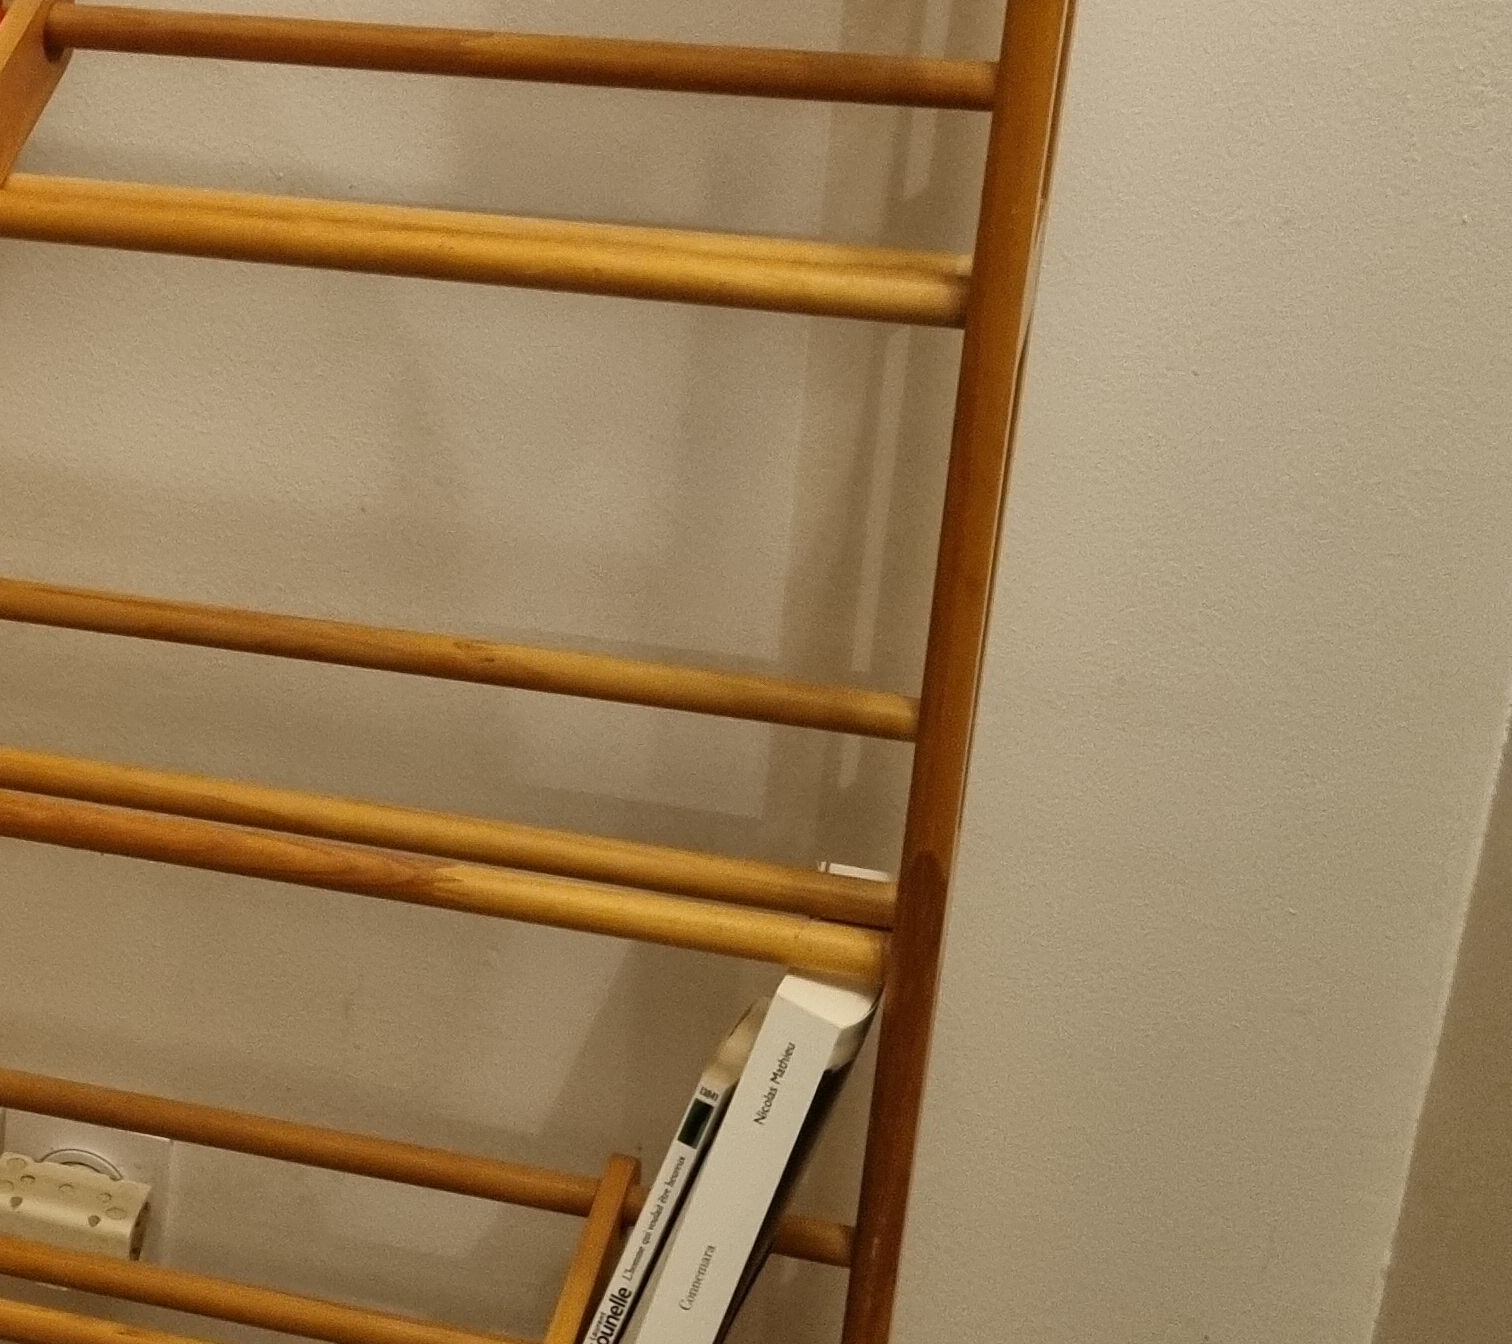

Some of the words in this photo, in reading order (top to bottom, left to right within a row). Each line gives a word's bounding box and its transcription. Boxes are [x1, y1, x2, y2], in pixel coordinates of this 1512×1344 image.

[753, 1086, 779, 1126] Nicolas
[770, 1041, 797, 1085] Mathieu
[678, 1243, 717, 1312] Connemara
